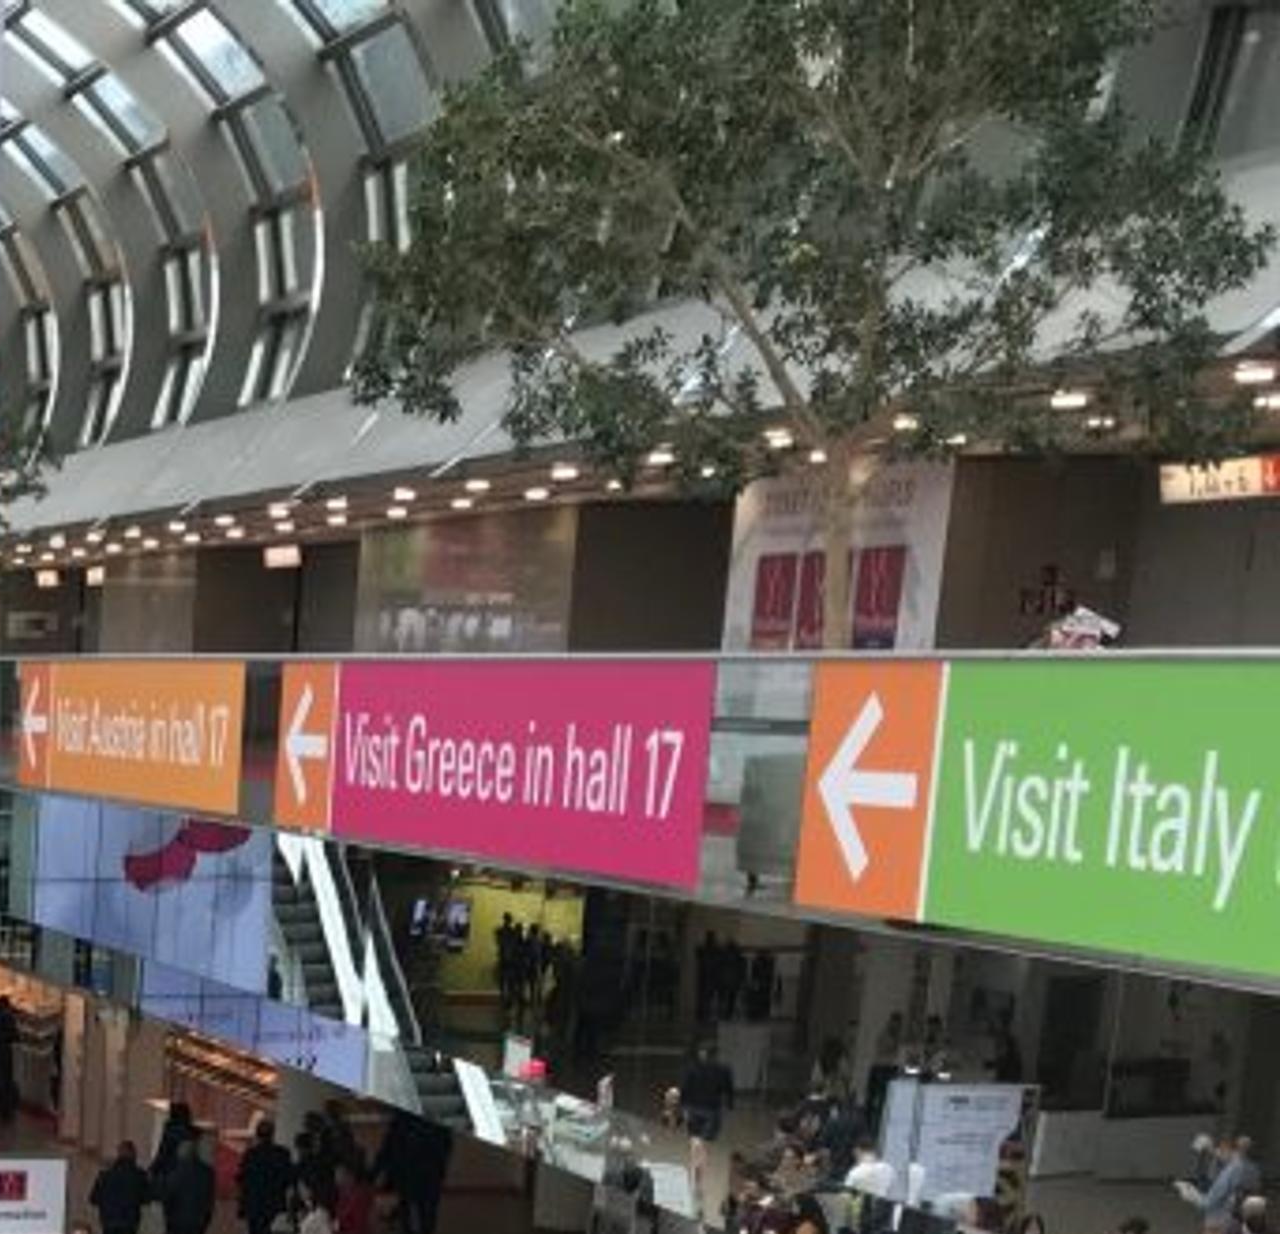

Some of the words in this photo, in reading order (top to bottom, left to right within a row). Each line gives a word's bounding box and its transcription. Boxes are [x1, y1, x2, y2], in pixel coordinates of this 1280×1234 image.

[211, 705, 230, 766] 17
[344, 711, 400, 791] Visit
[406, 717, 514, 800] Greece
[525, 722, 554, 806] in
[562, 723, 629, 814] hall
[644, 728, 685, 820] 17
[963, 738, 1090, 863] Visit
[1105, 745, 1262, 912] Italy
